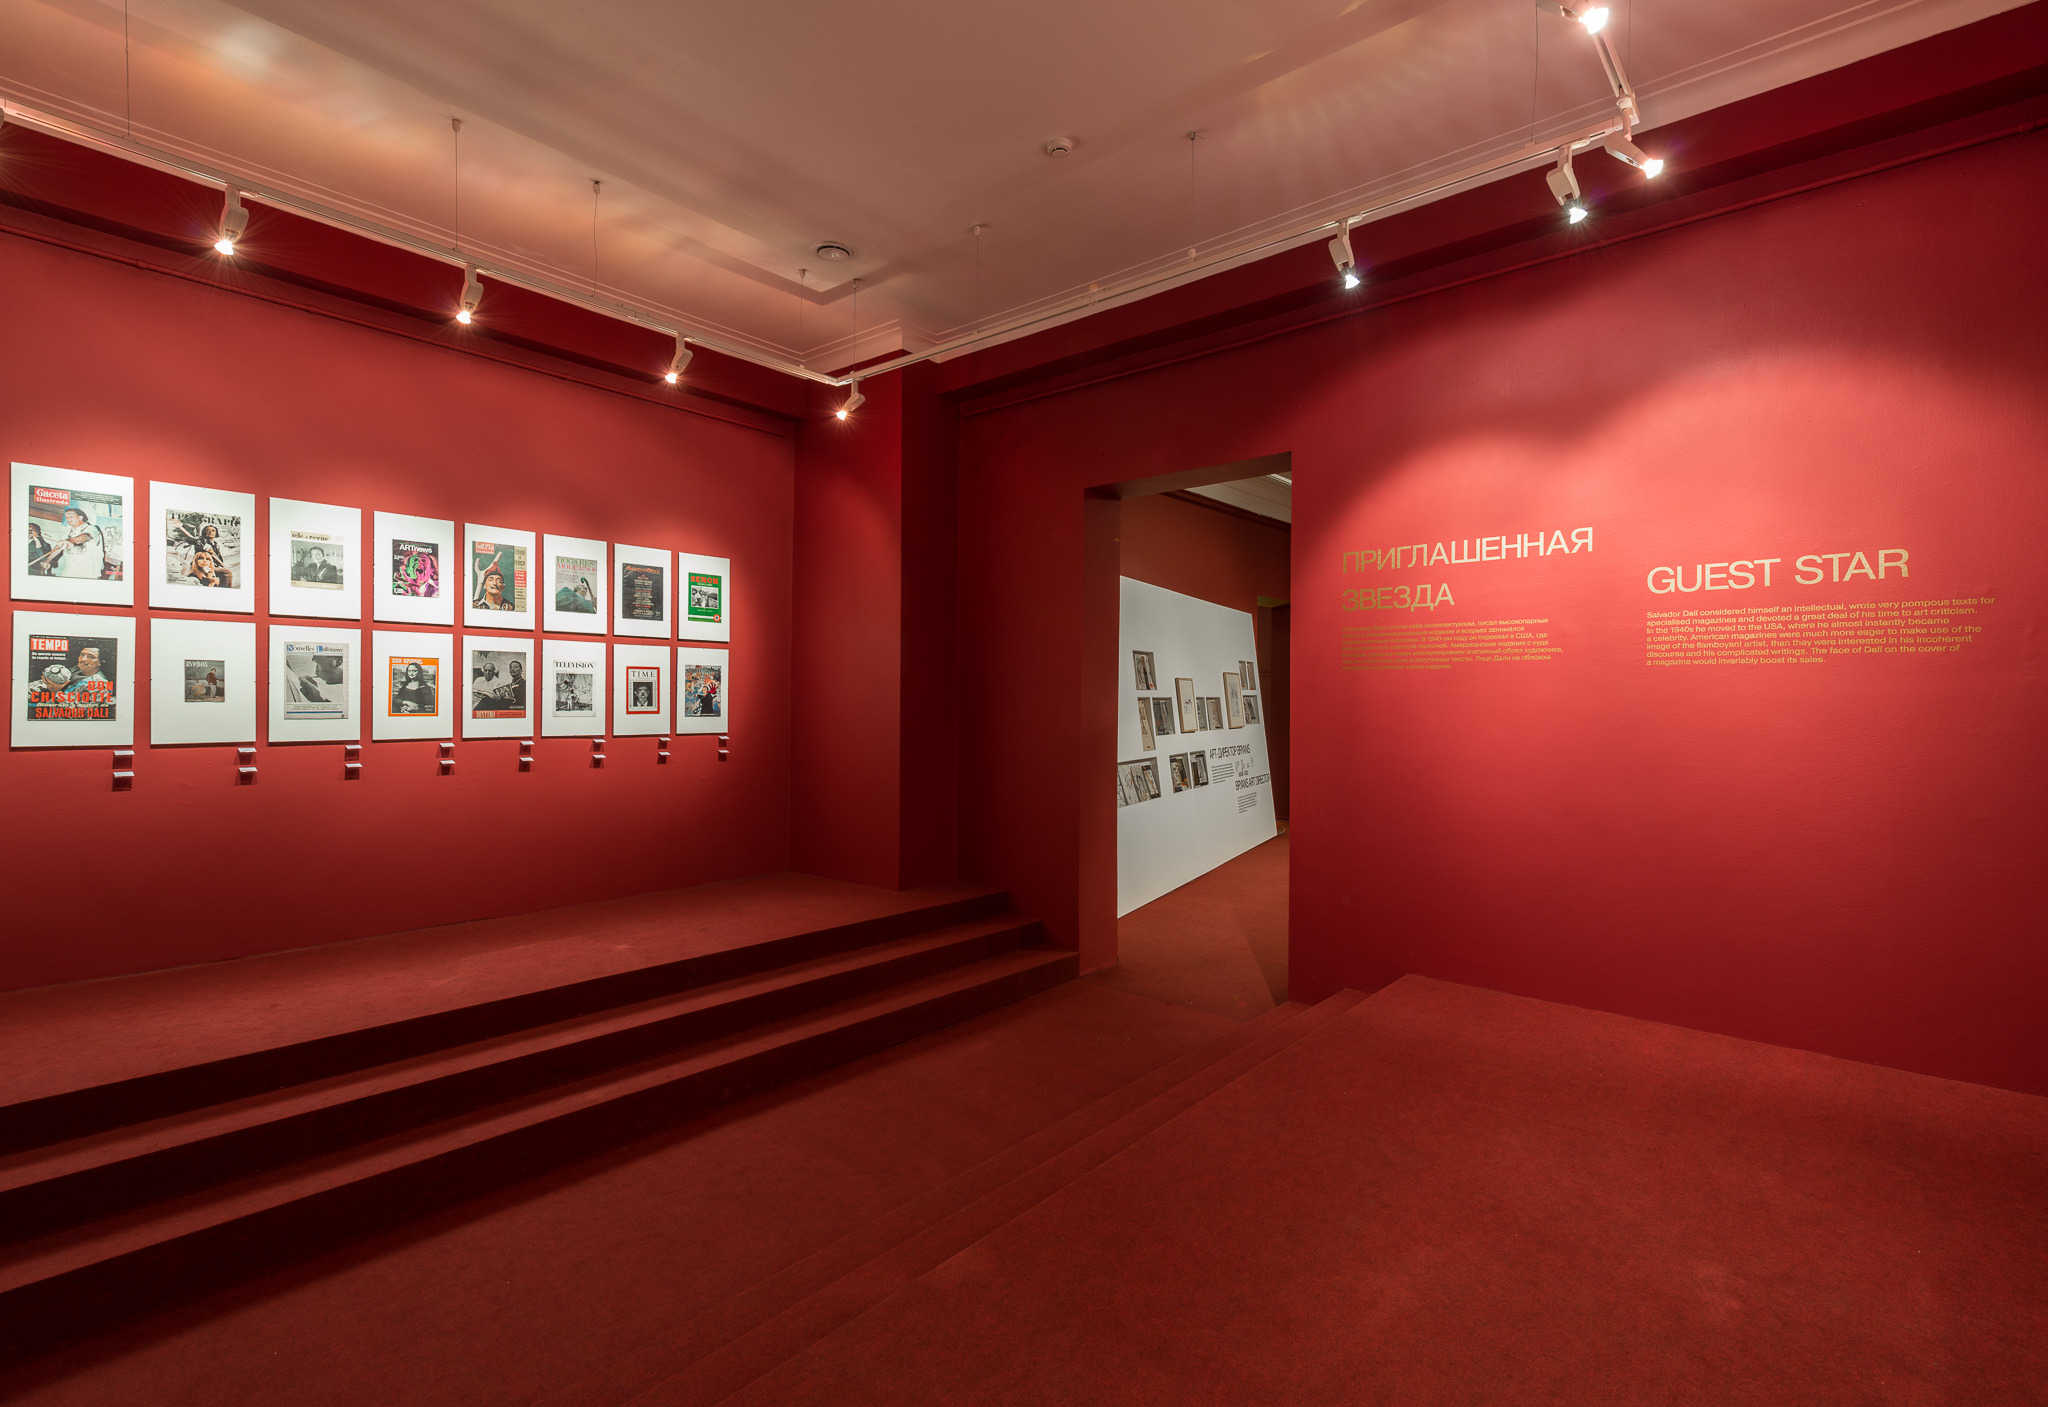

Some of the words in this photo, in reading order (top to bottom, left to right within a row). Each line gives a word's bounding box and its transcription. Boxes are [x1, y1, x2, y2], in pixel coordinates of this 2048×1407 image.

[36, 488, 68, 500] Gaceta
[400, 544, 432, 554] ARTnews
[1342, 526, 1592, 574] ПРИГЛАШЕННАЯ
[1647, 558, 1781, 594] GUEST
[1794, 548, 1910, 585] STAR
[1342, 583, 1454, 612] ЗВЕЗДА
[1700, 608, 1746, 616] considered
[1748, 606, 1779, 614] himself
[1794, 604, 1846, 612] intellectual,
[1902, 600, 1950, 608] pompous
[1647, 618, 1690, 627] specialised
[1692, 617, 1736, 625] magazines
[1802, 614, 1826, 622] great
[1931, 607, 1978, 615] criticism.
[1865, 618, 1906, 626] instantly
[1653, 634, 1688, 642] celebrity.
[1731, 632, 1777, 640] magazines
[1792, 639, 1812, 647] they
[1916, 635, 1972, 643] incoherent
[32, 638, 68, 650] TEMPO
[1717, 648, 1769, 657] complicated
[1771, 648, 1808, 656] writings.
[1653, 658, 1691, 666] magazine
[1718, 657, 1758, 665] invariably
[88, 681, 113, 691] DON
[31, 692, 113, 702] CHISCIOTTE
[36, 708, 84, 718] SALVADOR
[88, 708, 108, 718] DALI
